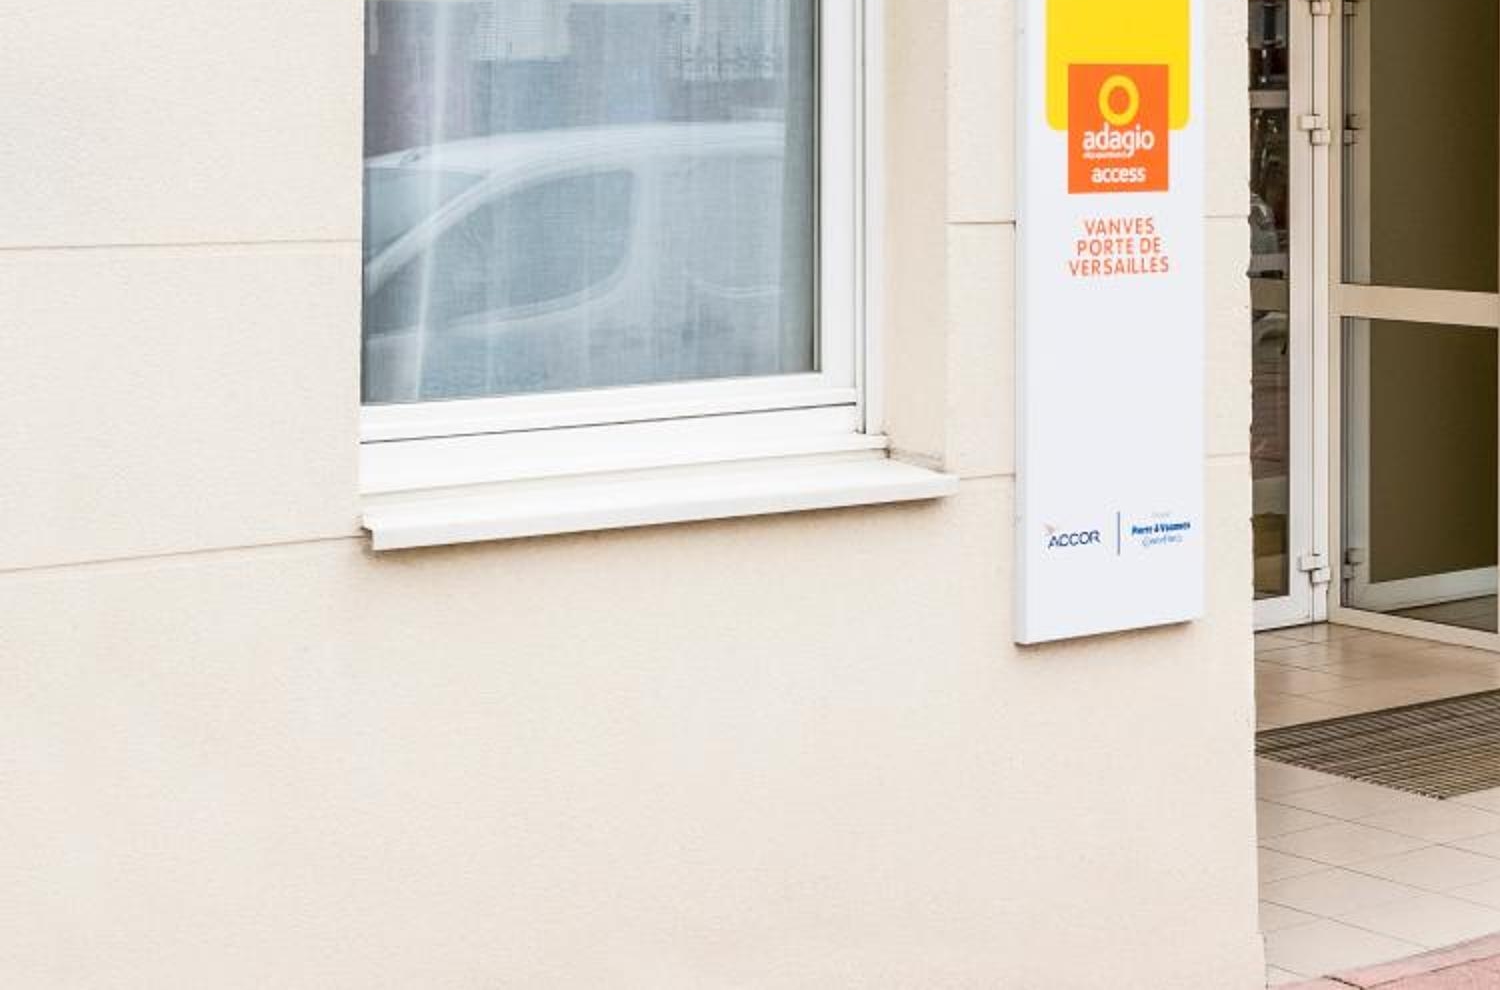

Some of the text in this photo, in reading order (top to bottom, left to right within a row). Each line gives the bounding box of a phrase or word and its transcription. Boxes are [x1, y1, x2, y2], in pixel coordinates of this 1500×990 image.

[1082, 122, 1155, 158] adagio
[1091, 167, 1146, 183] access
[1084, 217, 1155, 237] VANVES
[1077, 237, 1161, 257] PORTE DE
[1069, 256, 1169, 277] VERSAILLES
[1048, 530, 1101, 548] ACCOR
